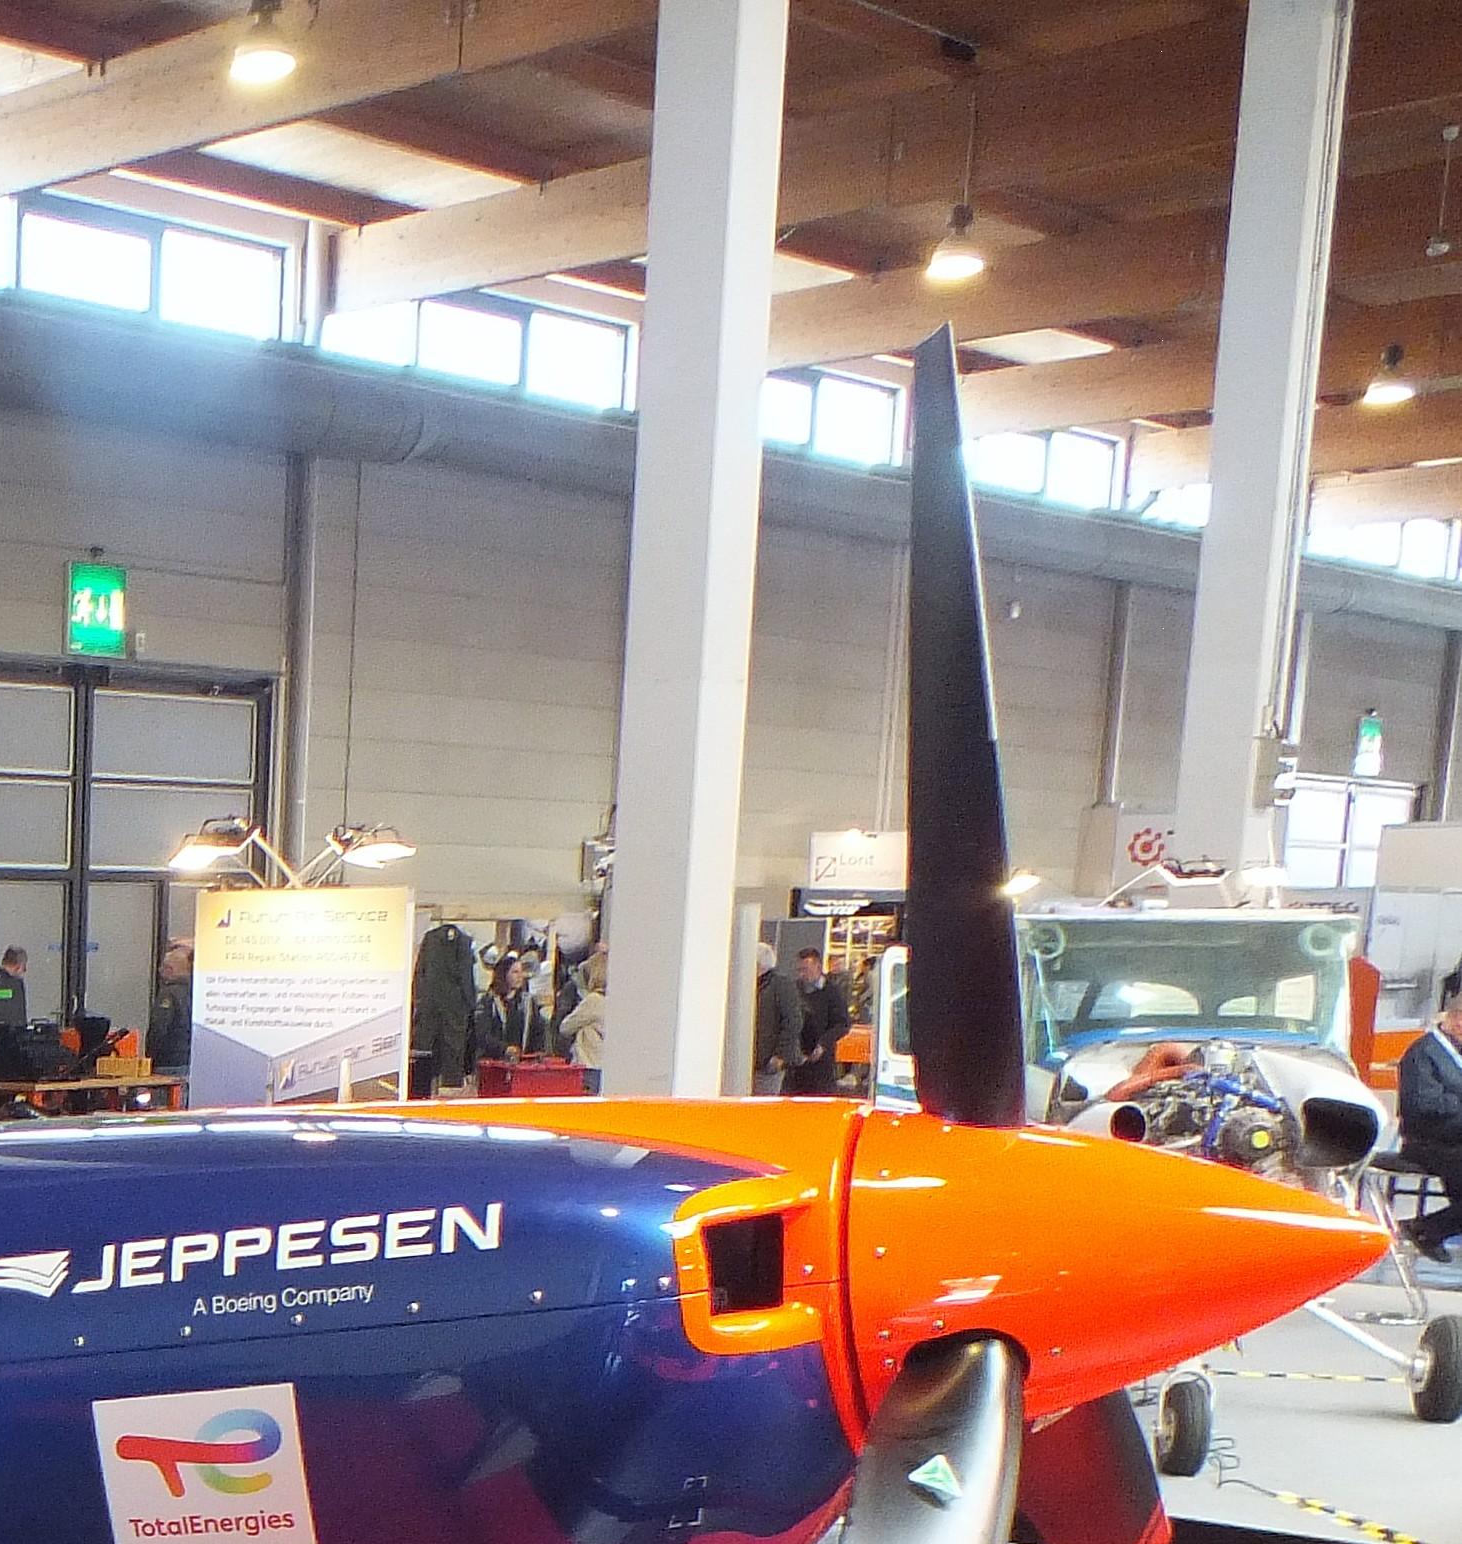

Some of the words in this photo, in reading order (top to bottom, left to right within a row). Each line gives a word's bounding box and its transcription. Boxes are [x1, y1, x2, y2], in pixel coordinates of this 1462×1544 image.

[71, 1202, 504, 1294] JEPPESEN
[192, 1298, 208, 1316] A
[212, 1293, 277, 1314] Boeing
[281, 1284, 374, 1307] Company
[129, 1509, 295, 1538] TotalEnergies
